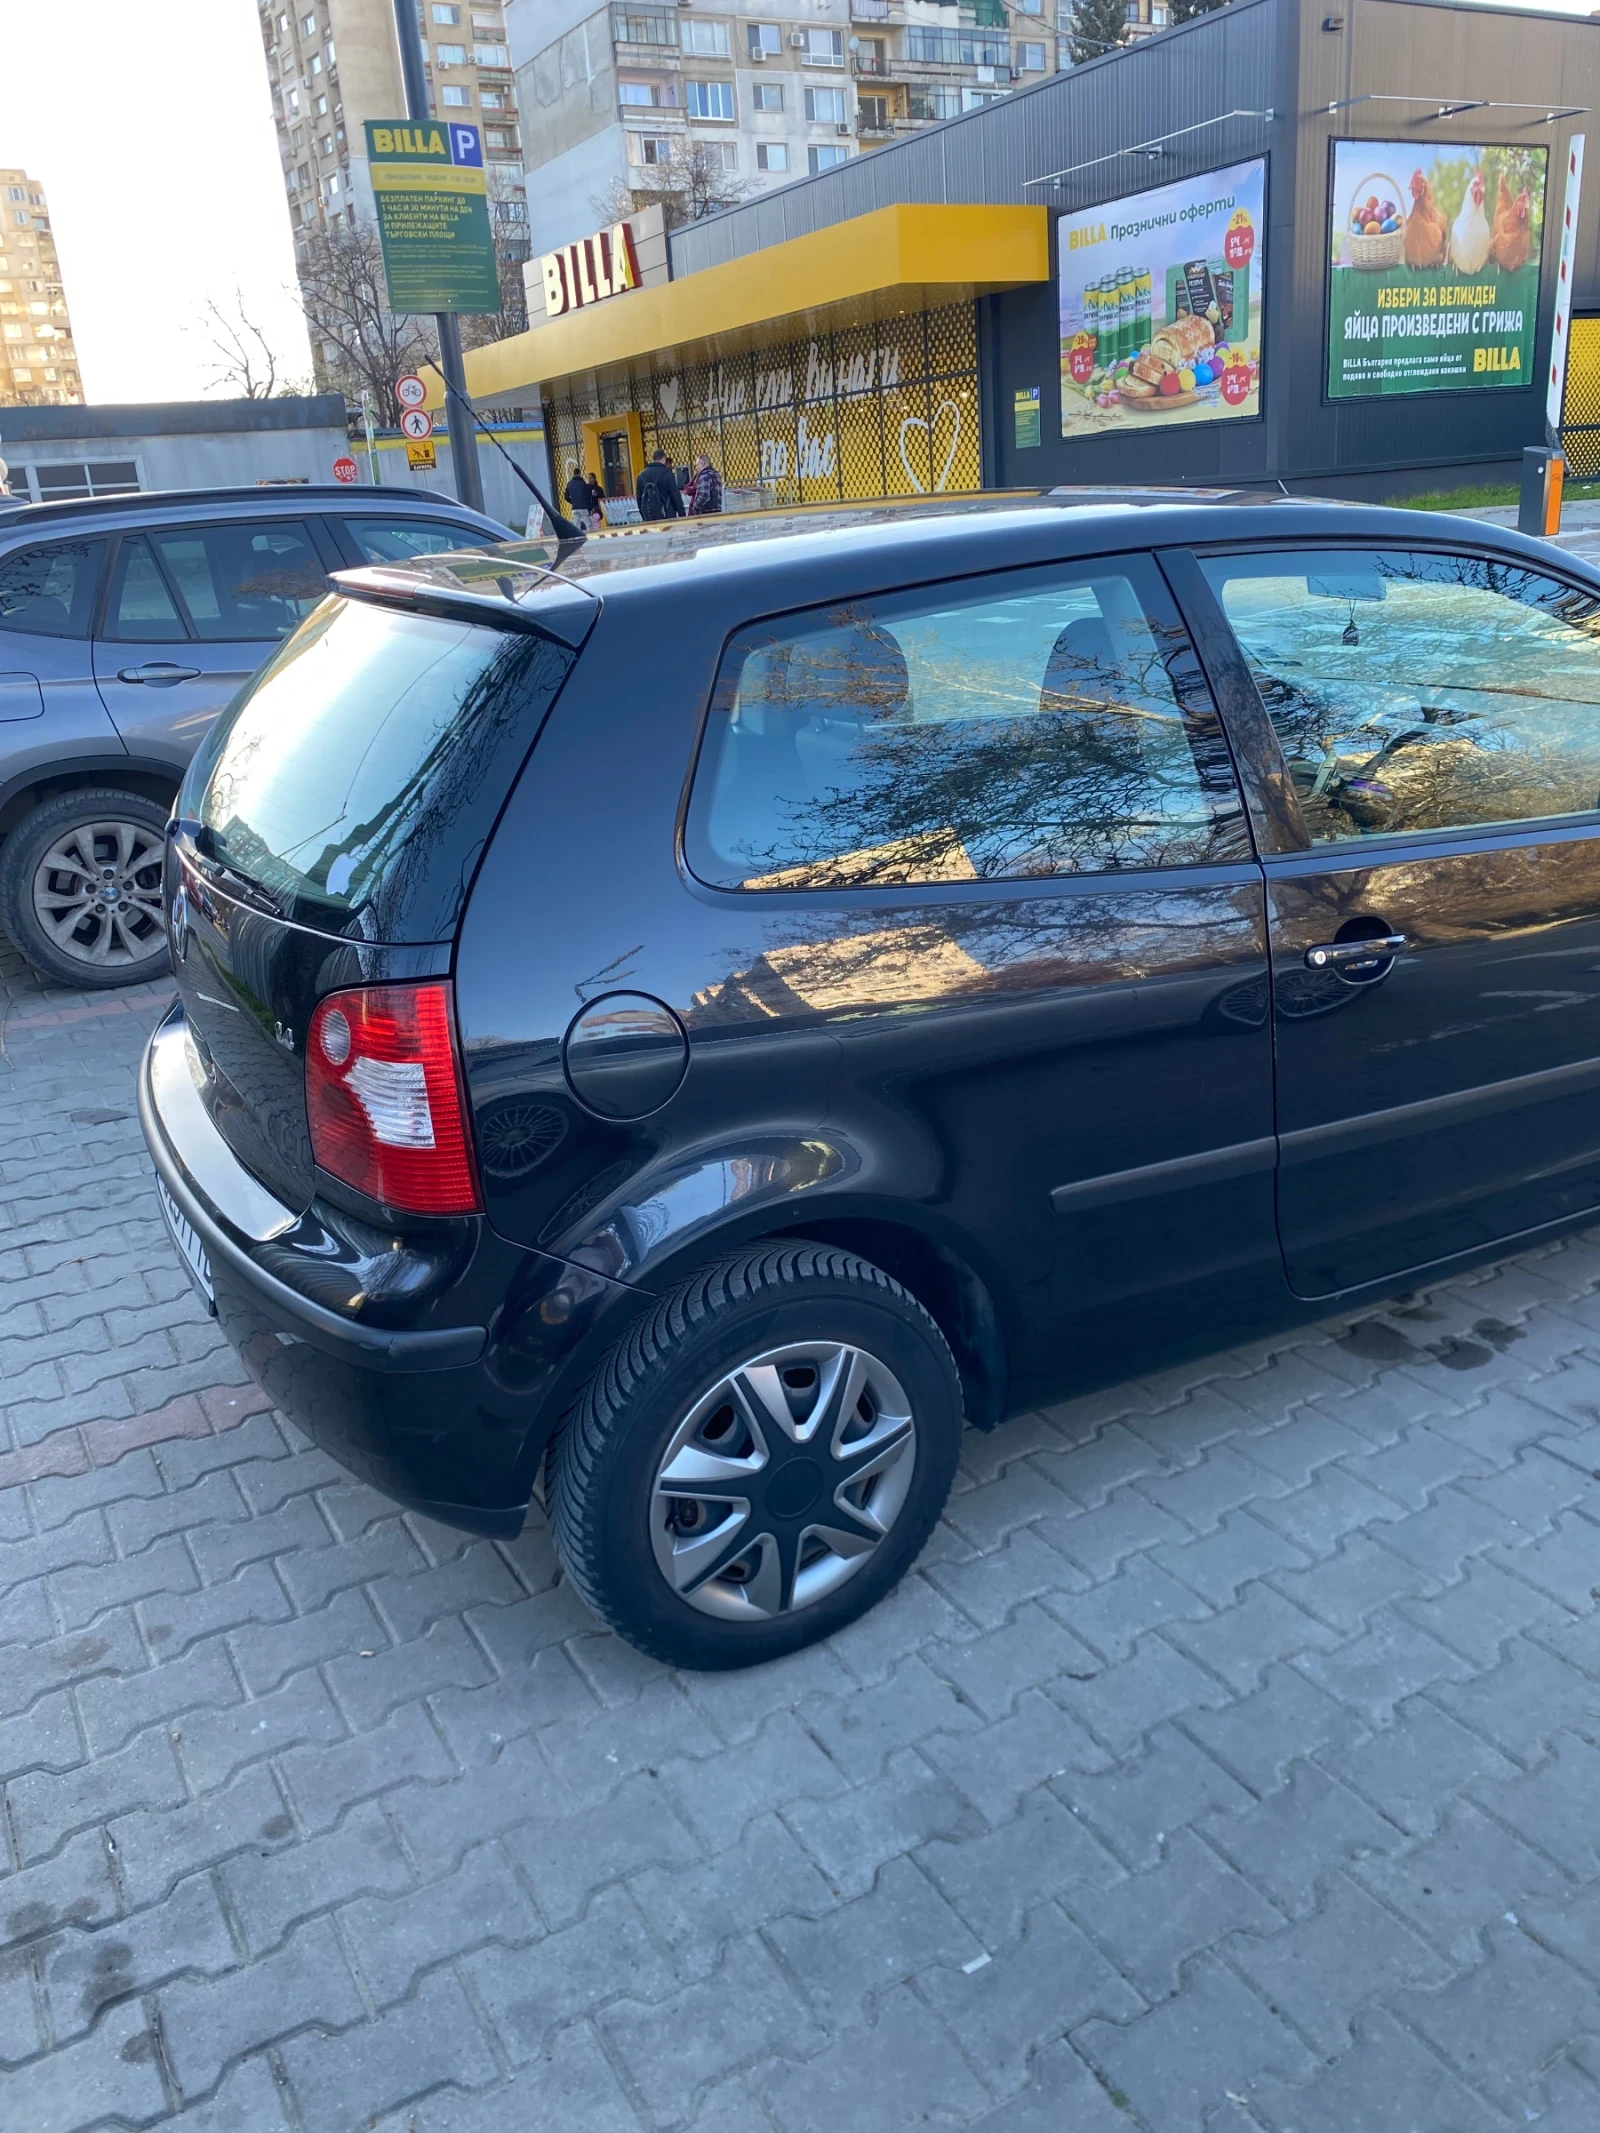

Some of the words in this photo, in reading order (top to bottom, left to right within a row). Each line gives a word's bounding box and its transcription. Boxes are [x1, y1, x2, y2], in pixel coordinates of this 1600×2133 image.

[373, 128, 446, 154] BILLA
[456, 129, 475, 159] P
[380, 195, 423, 203] БЕЗПЛАТЕН
[424, 195, 455, 203] ПАРКИНГ
[457, 196, 466, 205] ДО
[449, 205, 459, 213] НА
[460, 206, 473, 214] ДЕН
[429, 213, 439, 221] НА
[391, 222, 447, 230] ПРИЛЕЖАЩИТЕ
[1069, 223, 1107, 251] BILLA
[1110, 211, 1177, 241] Празнични
[1179, 196, 1236, 222] оферти
[385, 231, 428, 239] ТЪРГОВСКИ
[429, 231, 456, 240] ПЛОЩИ
[541, 222, 637, 317] BILLA
[1377, 287, 1421, 309] ИЗБЕРИ
[1422, 287, 1437, 307] ЗА
[1439, 285, 1497, 308] ВЕЛИКДЕН
[1343, 310, 1379, 342] ЯЙЦА
[1381, 312, 1470, 339] ПРОИЗВЕДЕНИ
[1472, 313, 1480, 333] С
[1482, 310, 1523, 334] ГРИЖА
[1343, 358, 1361, 368] BILLA
[1362, 358, 1393, 368] България
[1394, 357, 1422, 367] предлага
[1473, 346, 1521, 373] BILLA
[1373, 369, 1403, 379] свободно
[334, 465, 356, 476] STOP
